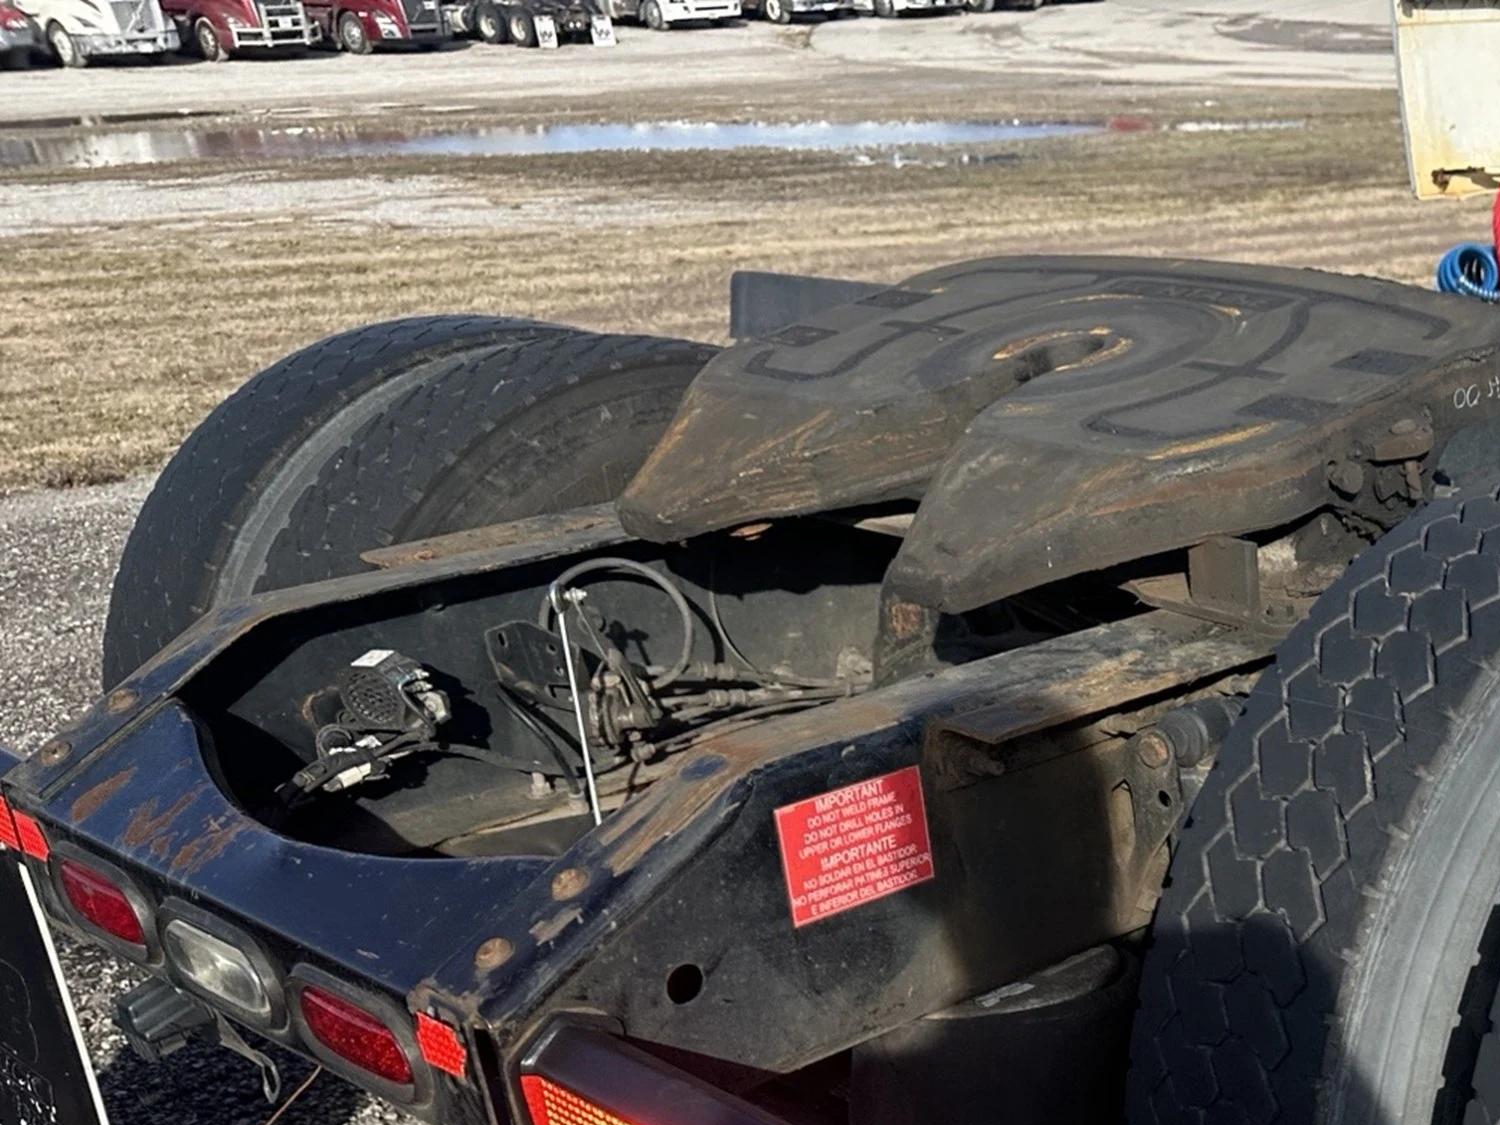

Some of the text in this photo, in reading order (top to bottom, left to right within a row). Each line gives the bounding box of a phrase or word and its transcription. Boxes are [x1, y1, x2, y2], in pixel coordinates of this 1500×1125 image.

[807, 791, 896, 828] DO NOT WELD FRAME
[814, 780, 884, 813] IMPORTANT
[799, 814, 912, 859] UPPER OR LOWER FLANGES
[804, 804, 904, 844] DO NOT DRILL HOLES IN
[804, 844, 918, 891] NO SOLDAR EN EL BASTIDOR
[821, 835, 897, 871] IMPORTANTE
[793, 852, 931, 906] NO PERFORAR PATINES SUPERIOR
[811, 870, 918, 916] E INFERIOR DEL BASTIDOR
